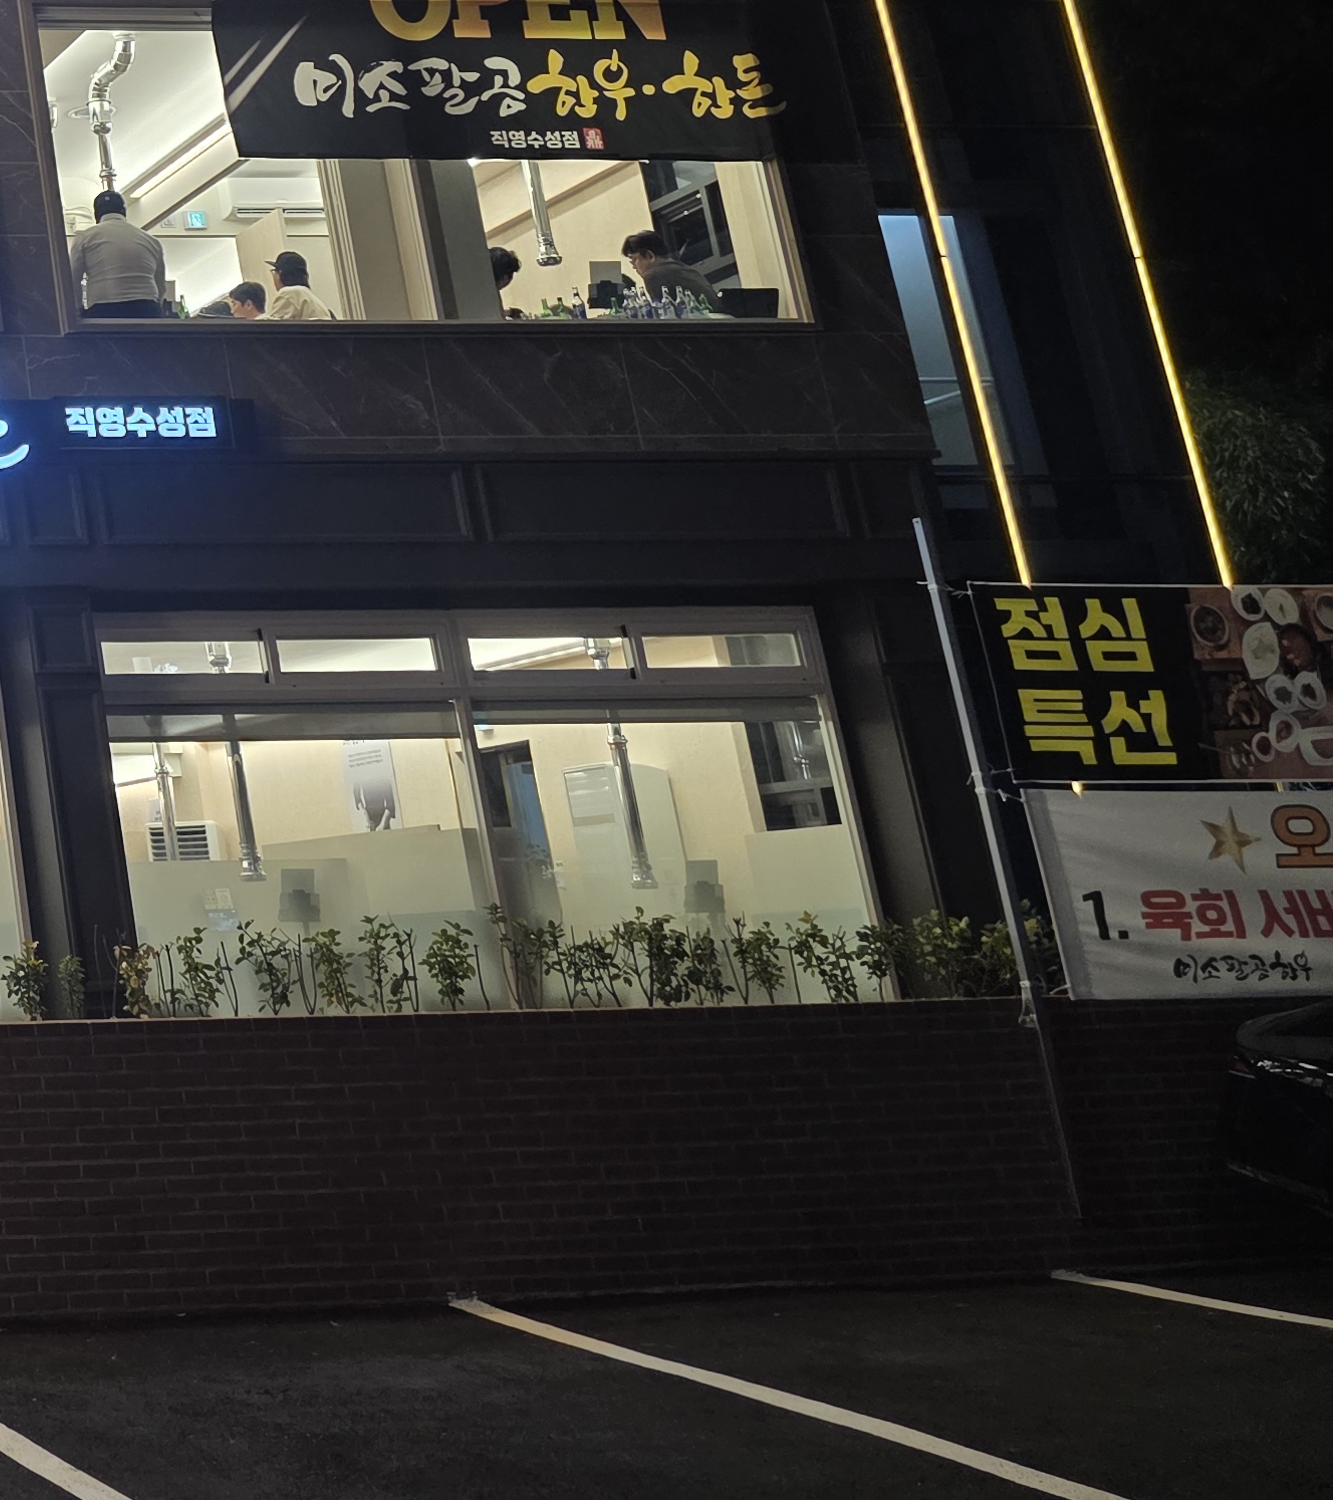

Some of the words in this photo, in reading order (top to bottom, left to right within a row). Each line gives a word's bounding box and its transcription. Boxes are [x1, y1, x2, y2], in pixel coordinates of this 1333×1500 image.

[489, 129, 581, 149] 직영수성점
[64, 406, 217, 438] 직영수성점
[994, 596, 1155, 672] 점심
[1017, 689, 1178, 765] 특선
[1140, 888, 1247, 941] 육회
